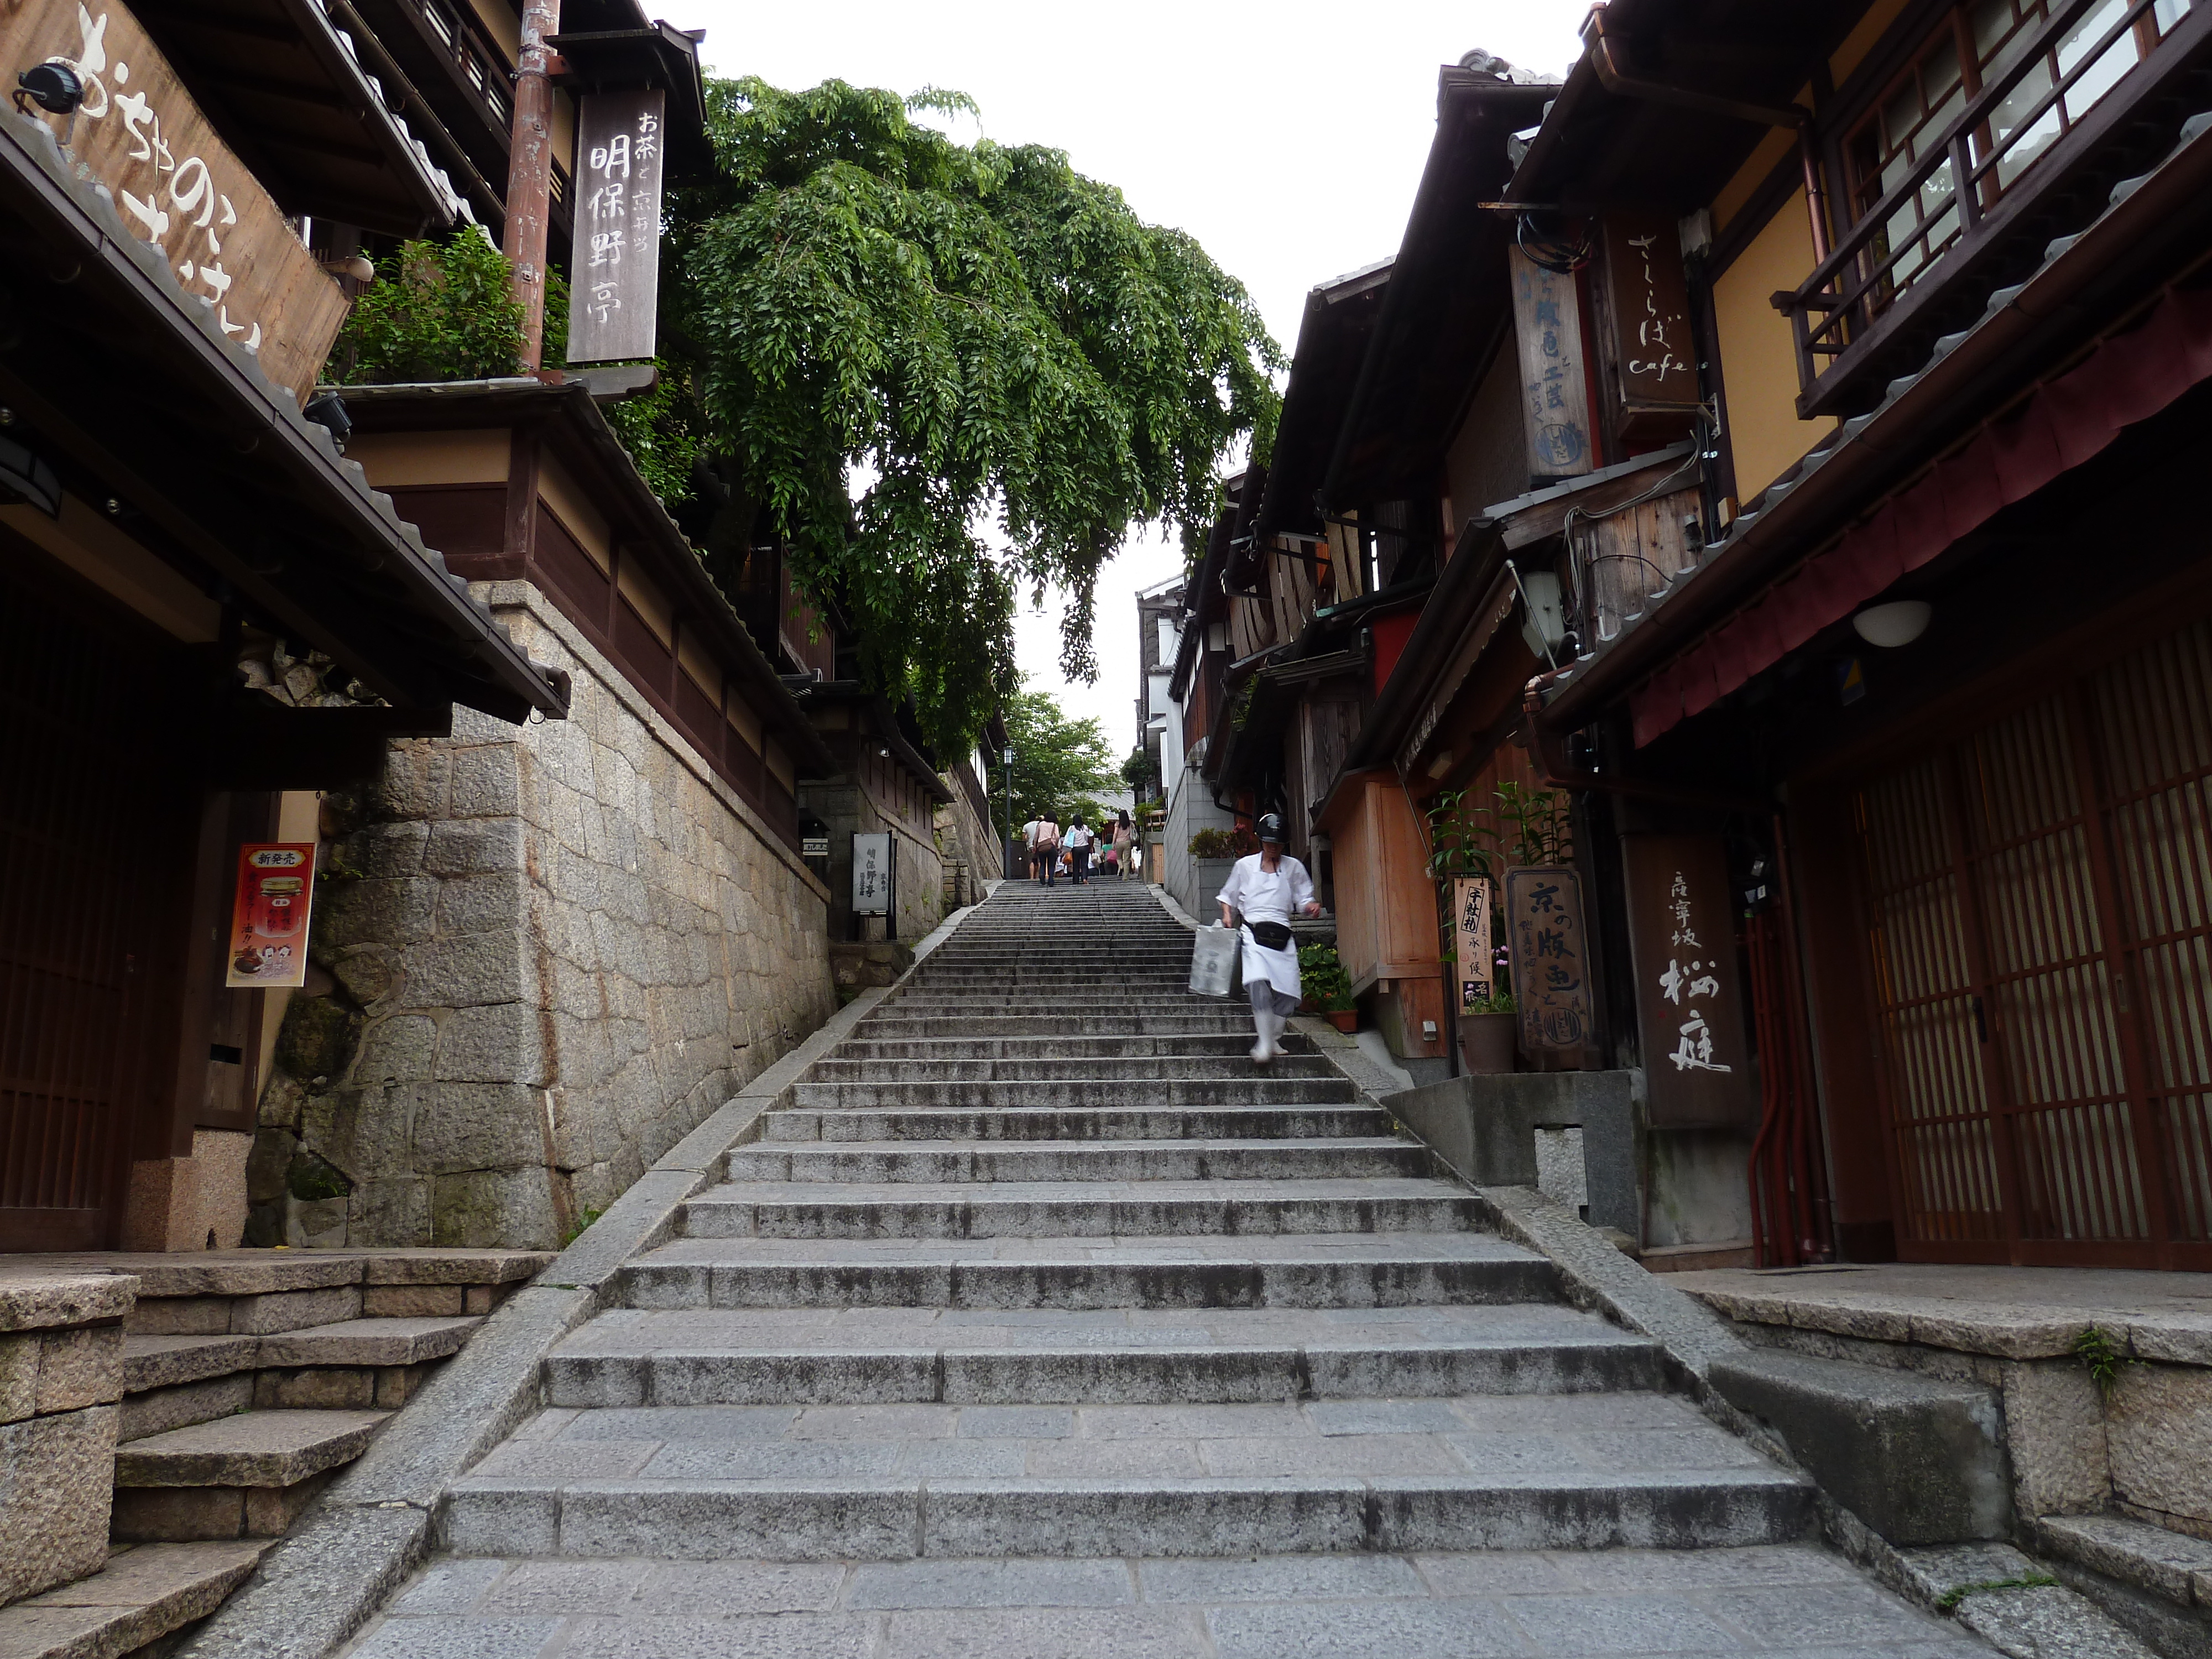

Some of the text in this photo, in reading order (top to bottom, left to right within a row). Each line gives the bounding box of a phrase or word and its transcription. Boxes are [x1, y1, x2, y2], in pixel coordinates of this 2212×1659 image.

[587, 134, 630, 324] 明保野亭
[1627, 234, 1682, 349] さくらば
[258, 852, 296, 865] 新発売
[867, 848, 876, 898] 明保野亭
[1463, 890, 1483, 931] 千社札
